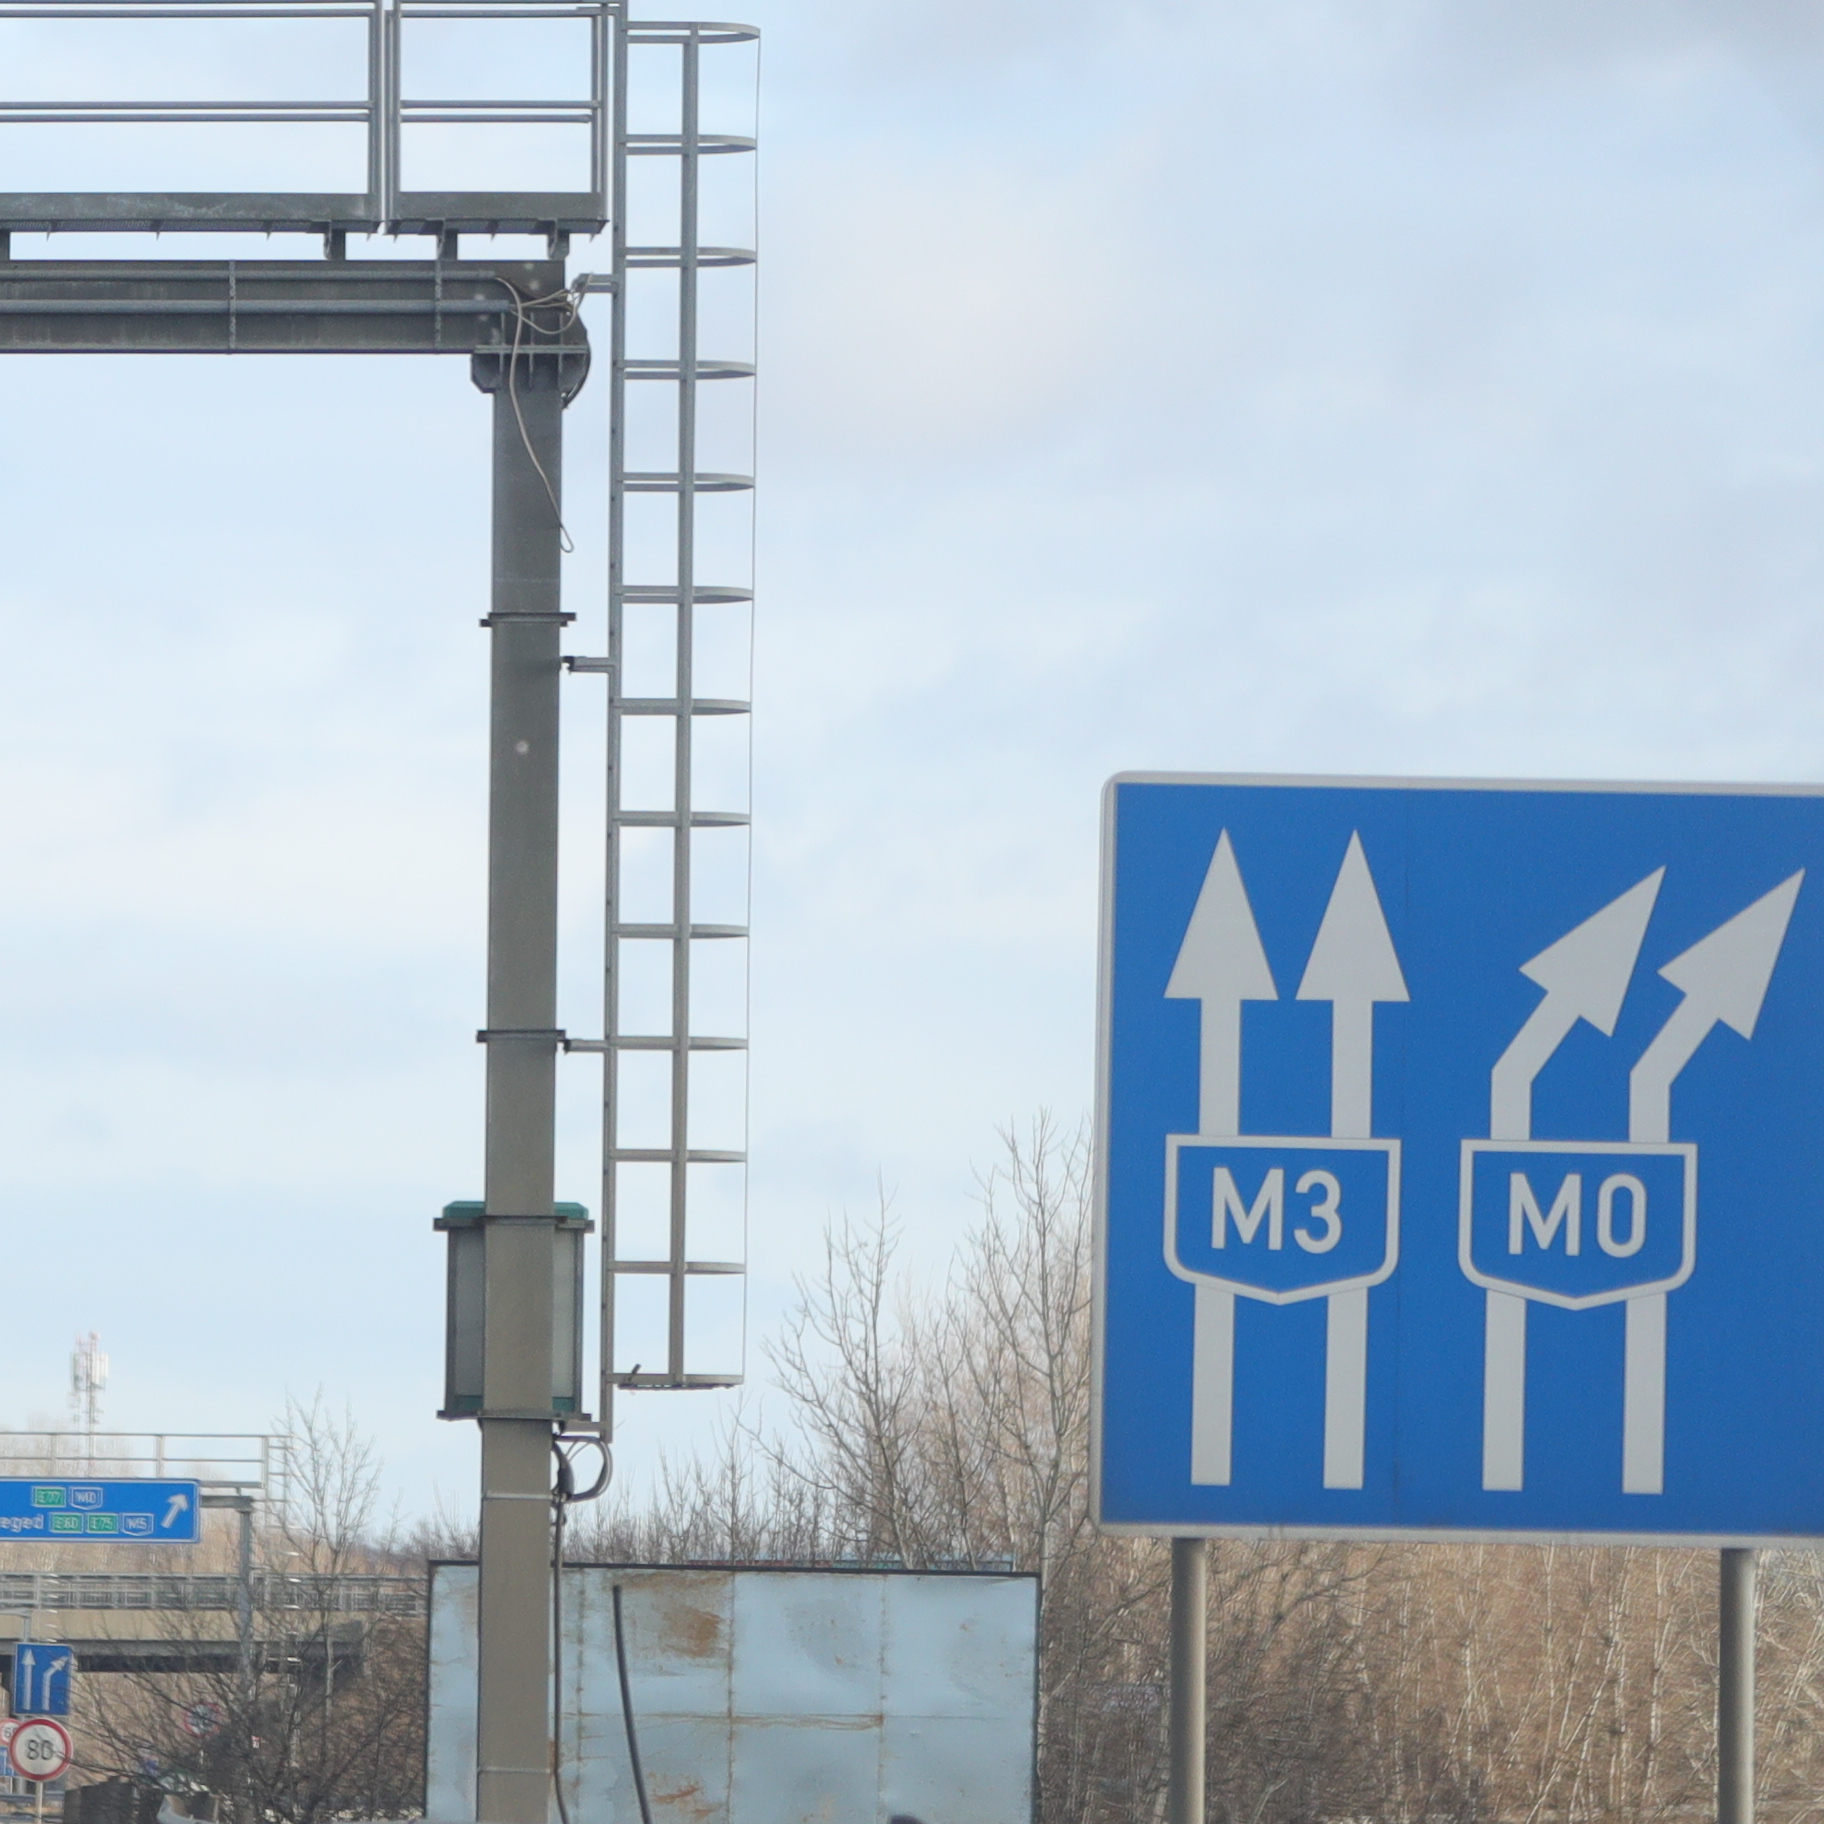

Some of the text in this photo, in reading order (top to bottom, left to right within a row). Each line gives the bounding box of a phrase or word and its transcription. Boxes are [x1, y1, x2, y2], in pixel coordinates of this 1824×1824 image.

[1210, 1166, 1343, 1255] M3
[1508, 1172, 1647, 1259] M0
[27, 1739, 54, 1761] 80
